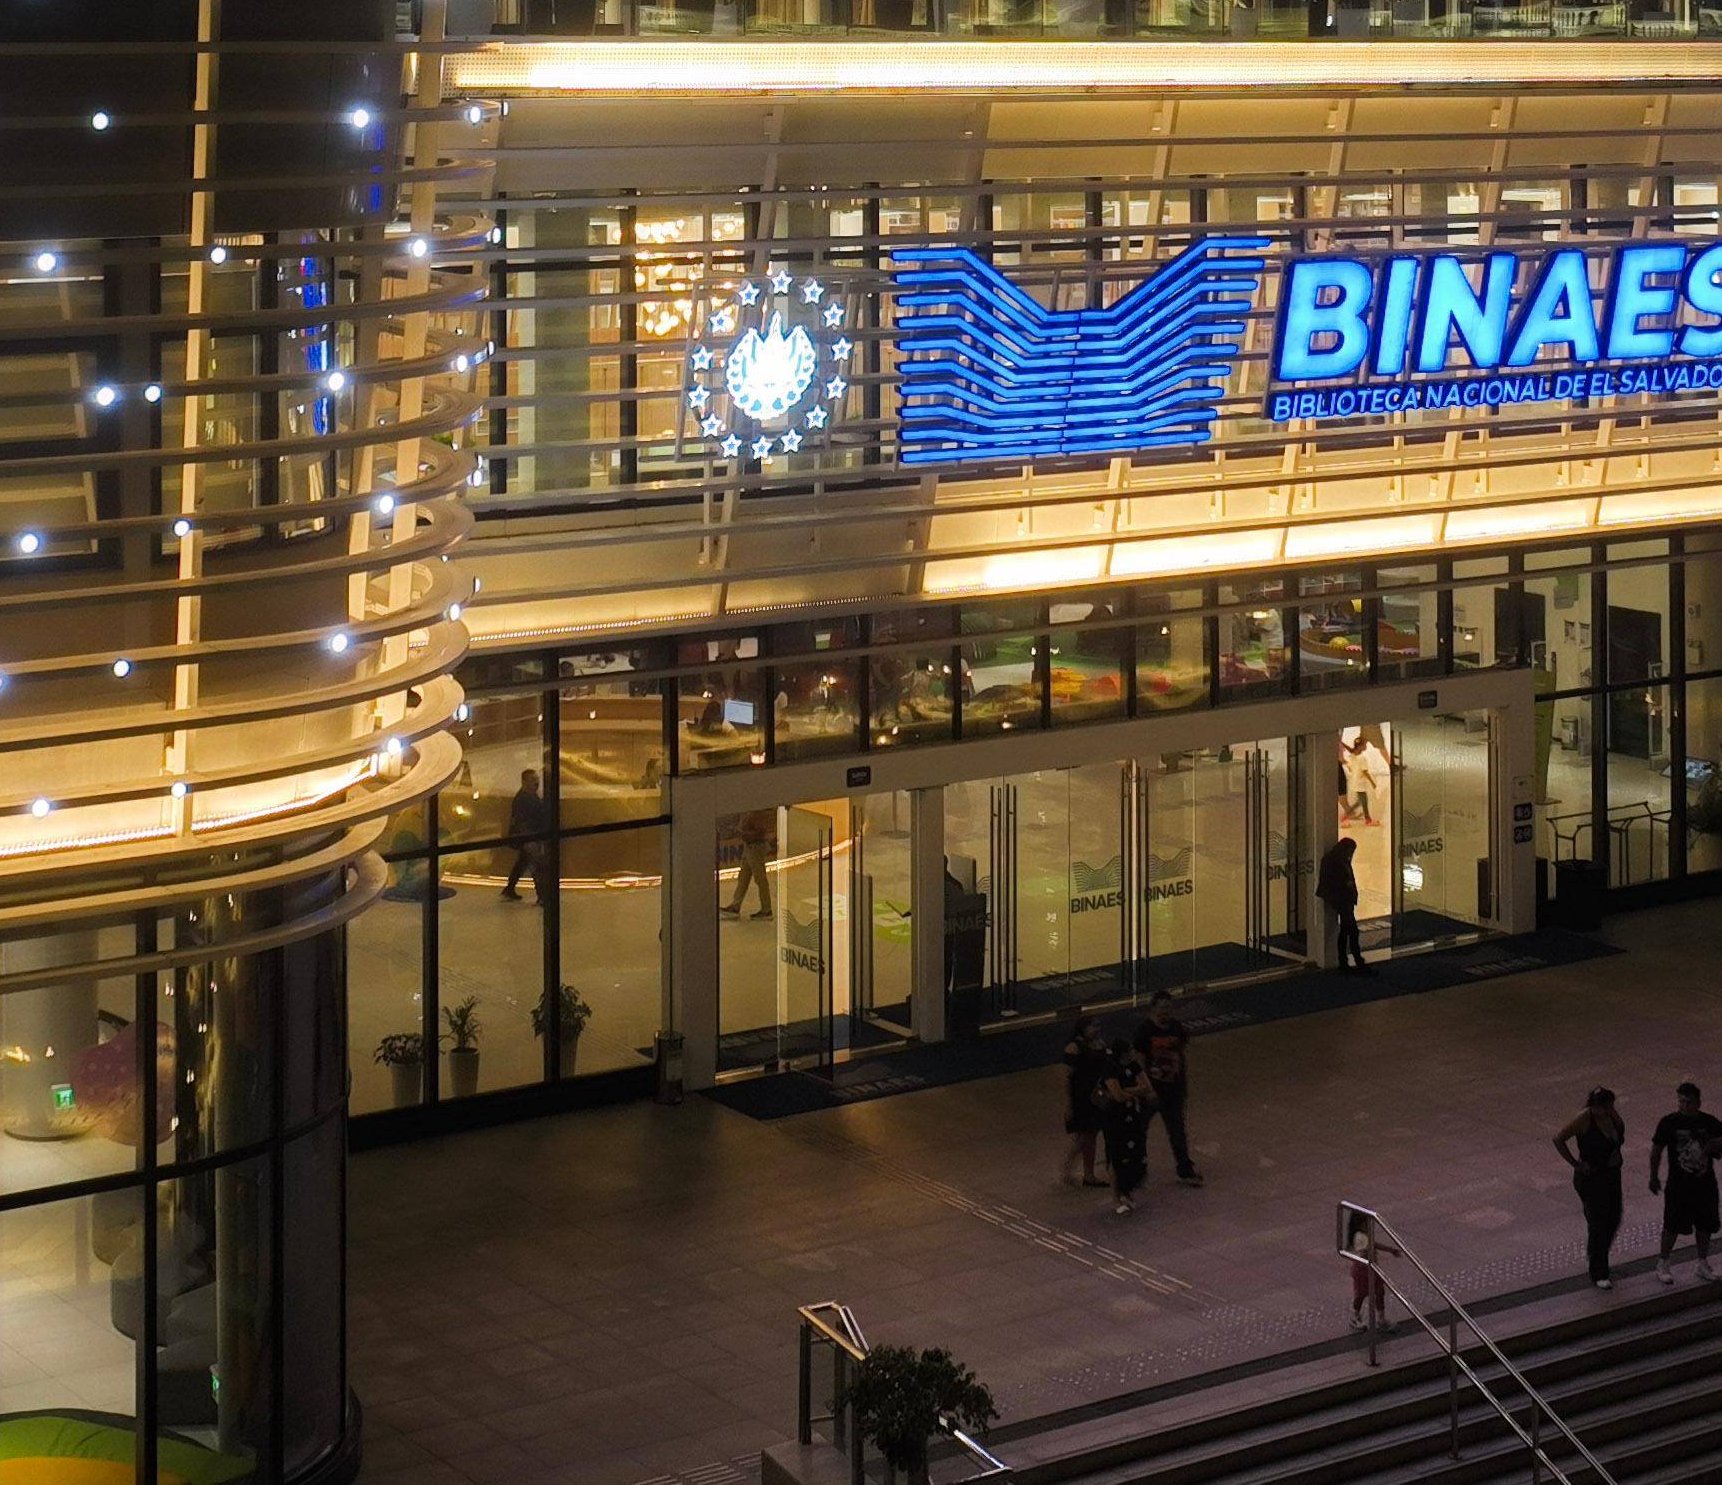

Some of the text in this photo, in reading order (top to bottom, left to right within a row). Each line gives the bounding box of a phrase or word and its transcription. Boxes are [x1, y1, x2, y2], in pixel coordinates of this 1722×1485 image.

[1272, 386, 1419, 421] BIBLIOTECA
[1425, 375, 1550, 409] NACIONAL
[1554, 373, 1587, 399] DE
[1589, 372, 1615, 396] EL
[1070, 890, 1126, 914] BINAES
[1143, 878, 1194, 903] BINAES
[780, 946, 826, 975] BINAES
